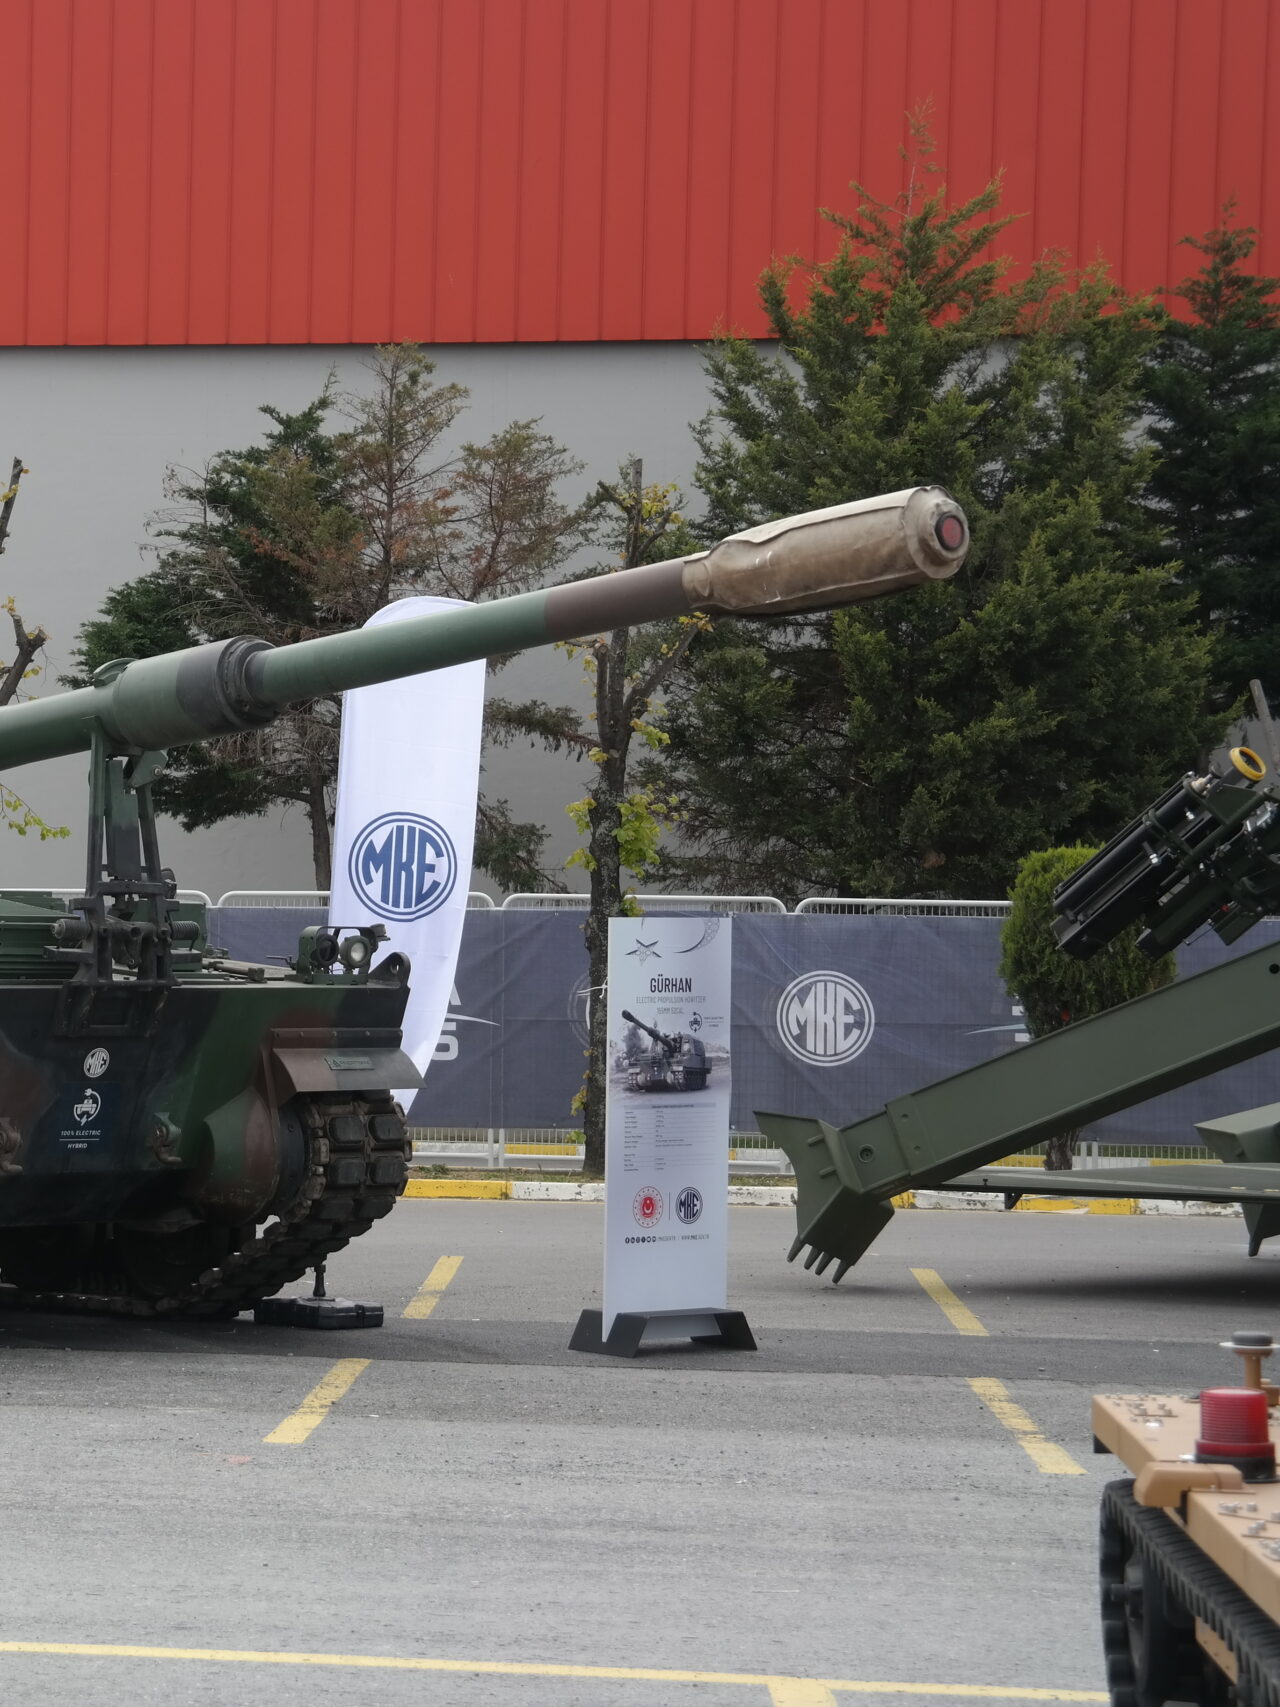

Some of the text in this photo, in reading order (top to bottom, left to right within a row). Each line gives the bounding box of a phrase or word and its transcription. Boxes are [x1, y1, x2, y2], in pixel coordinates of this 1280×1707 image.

[361, 825, 445, 909] MKE
[649, 973, 692, 993] GÜRHAN
[788, 982, 861, 1055] MKE
[86, 1051, 107, 1075] MKE
[679, 1191, 699, 1220] MKE
